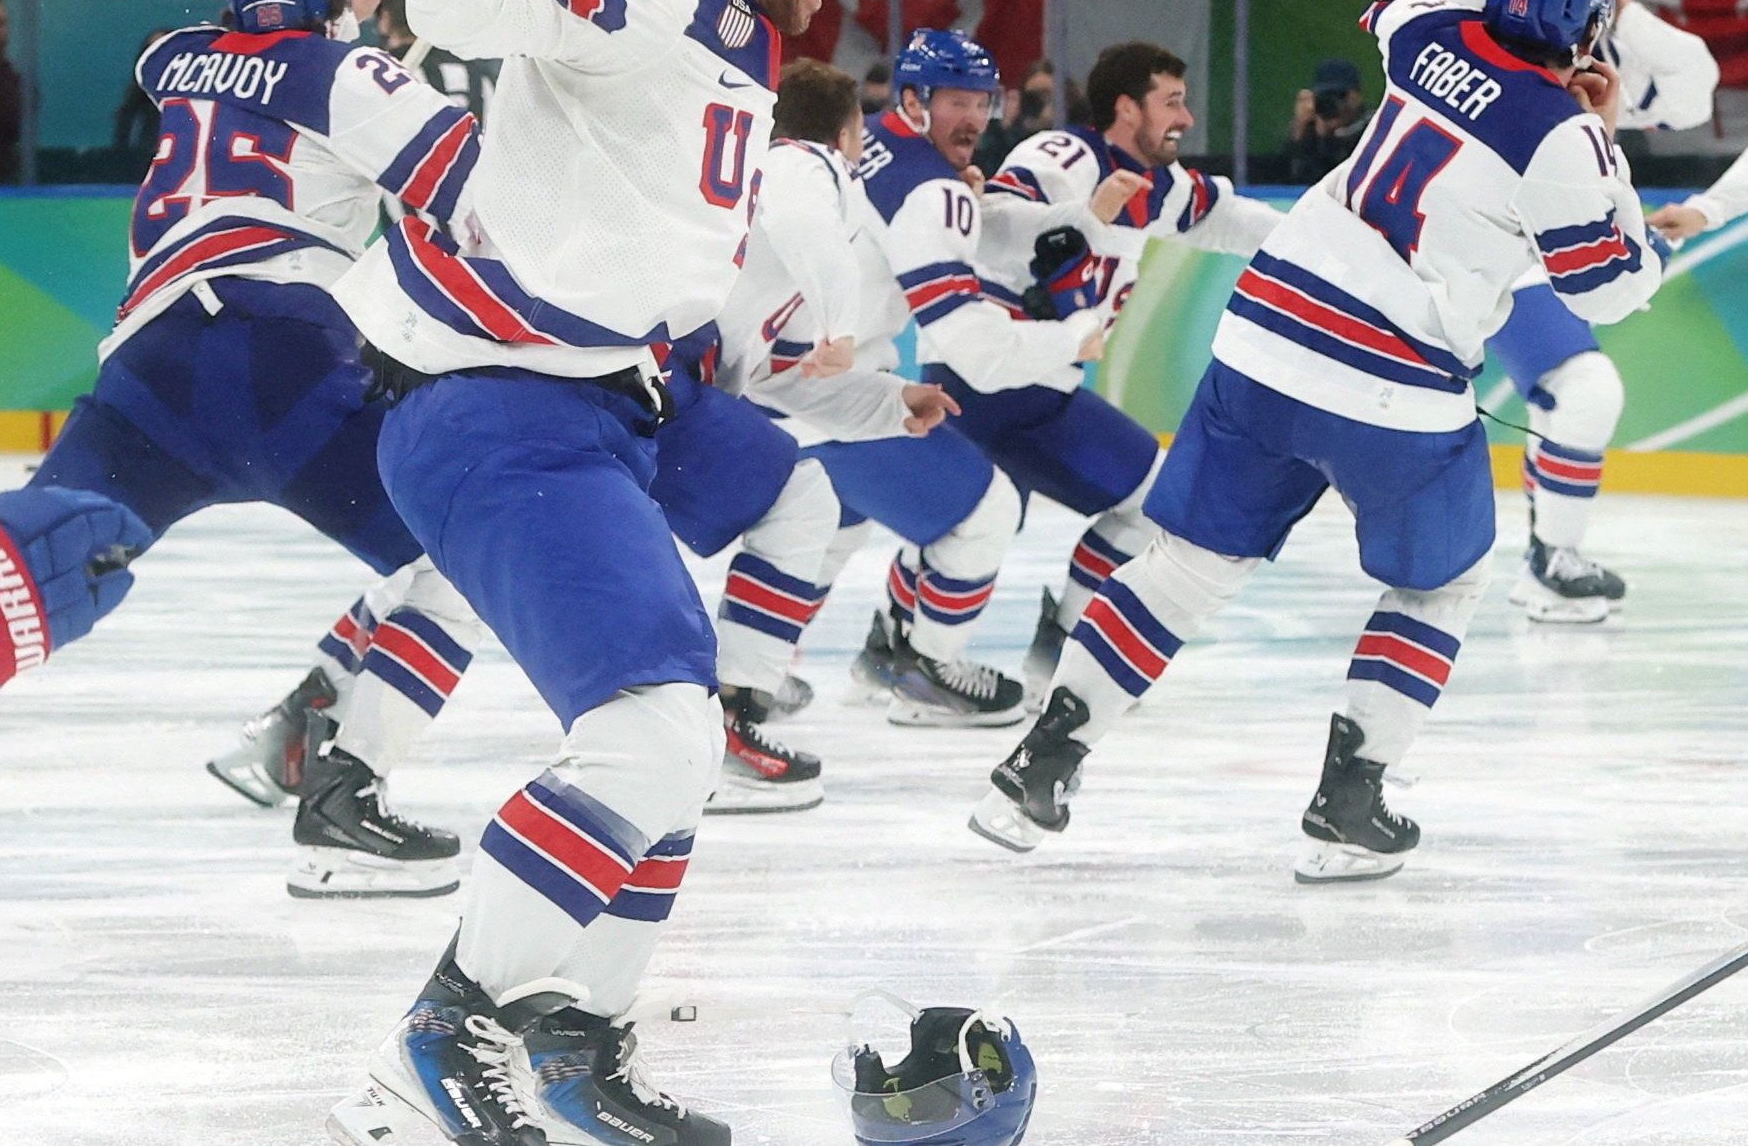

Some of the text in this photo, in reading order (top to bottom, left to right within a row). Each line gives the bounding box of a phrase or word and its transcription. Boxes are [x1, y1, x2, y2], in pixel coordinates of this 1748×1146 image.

[256, 3, 284, 27] 25
[156, 52, 287, 104] MCAVOY
[1409, 41, 1502, 121] FABER
[131, 97, 301, 259] 25
[1038, 134, 1087, 171] 21
[1345, 93, 1465, 268] 14
[942, 186, 974, 237] 10
[440, 1076, 483, 1130] BAUER
[596, 1109, 654, 1144] BAUER
